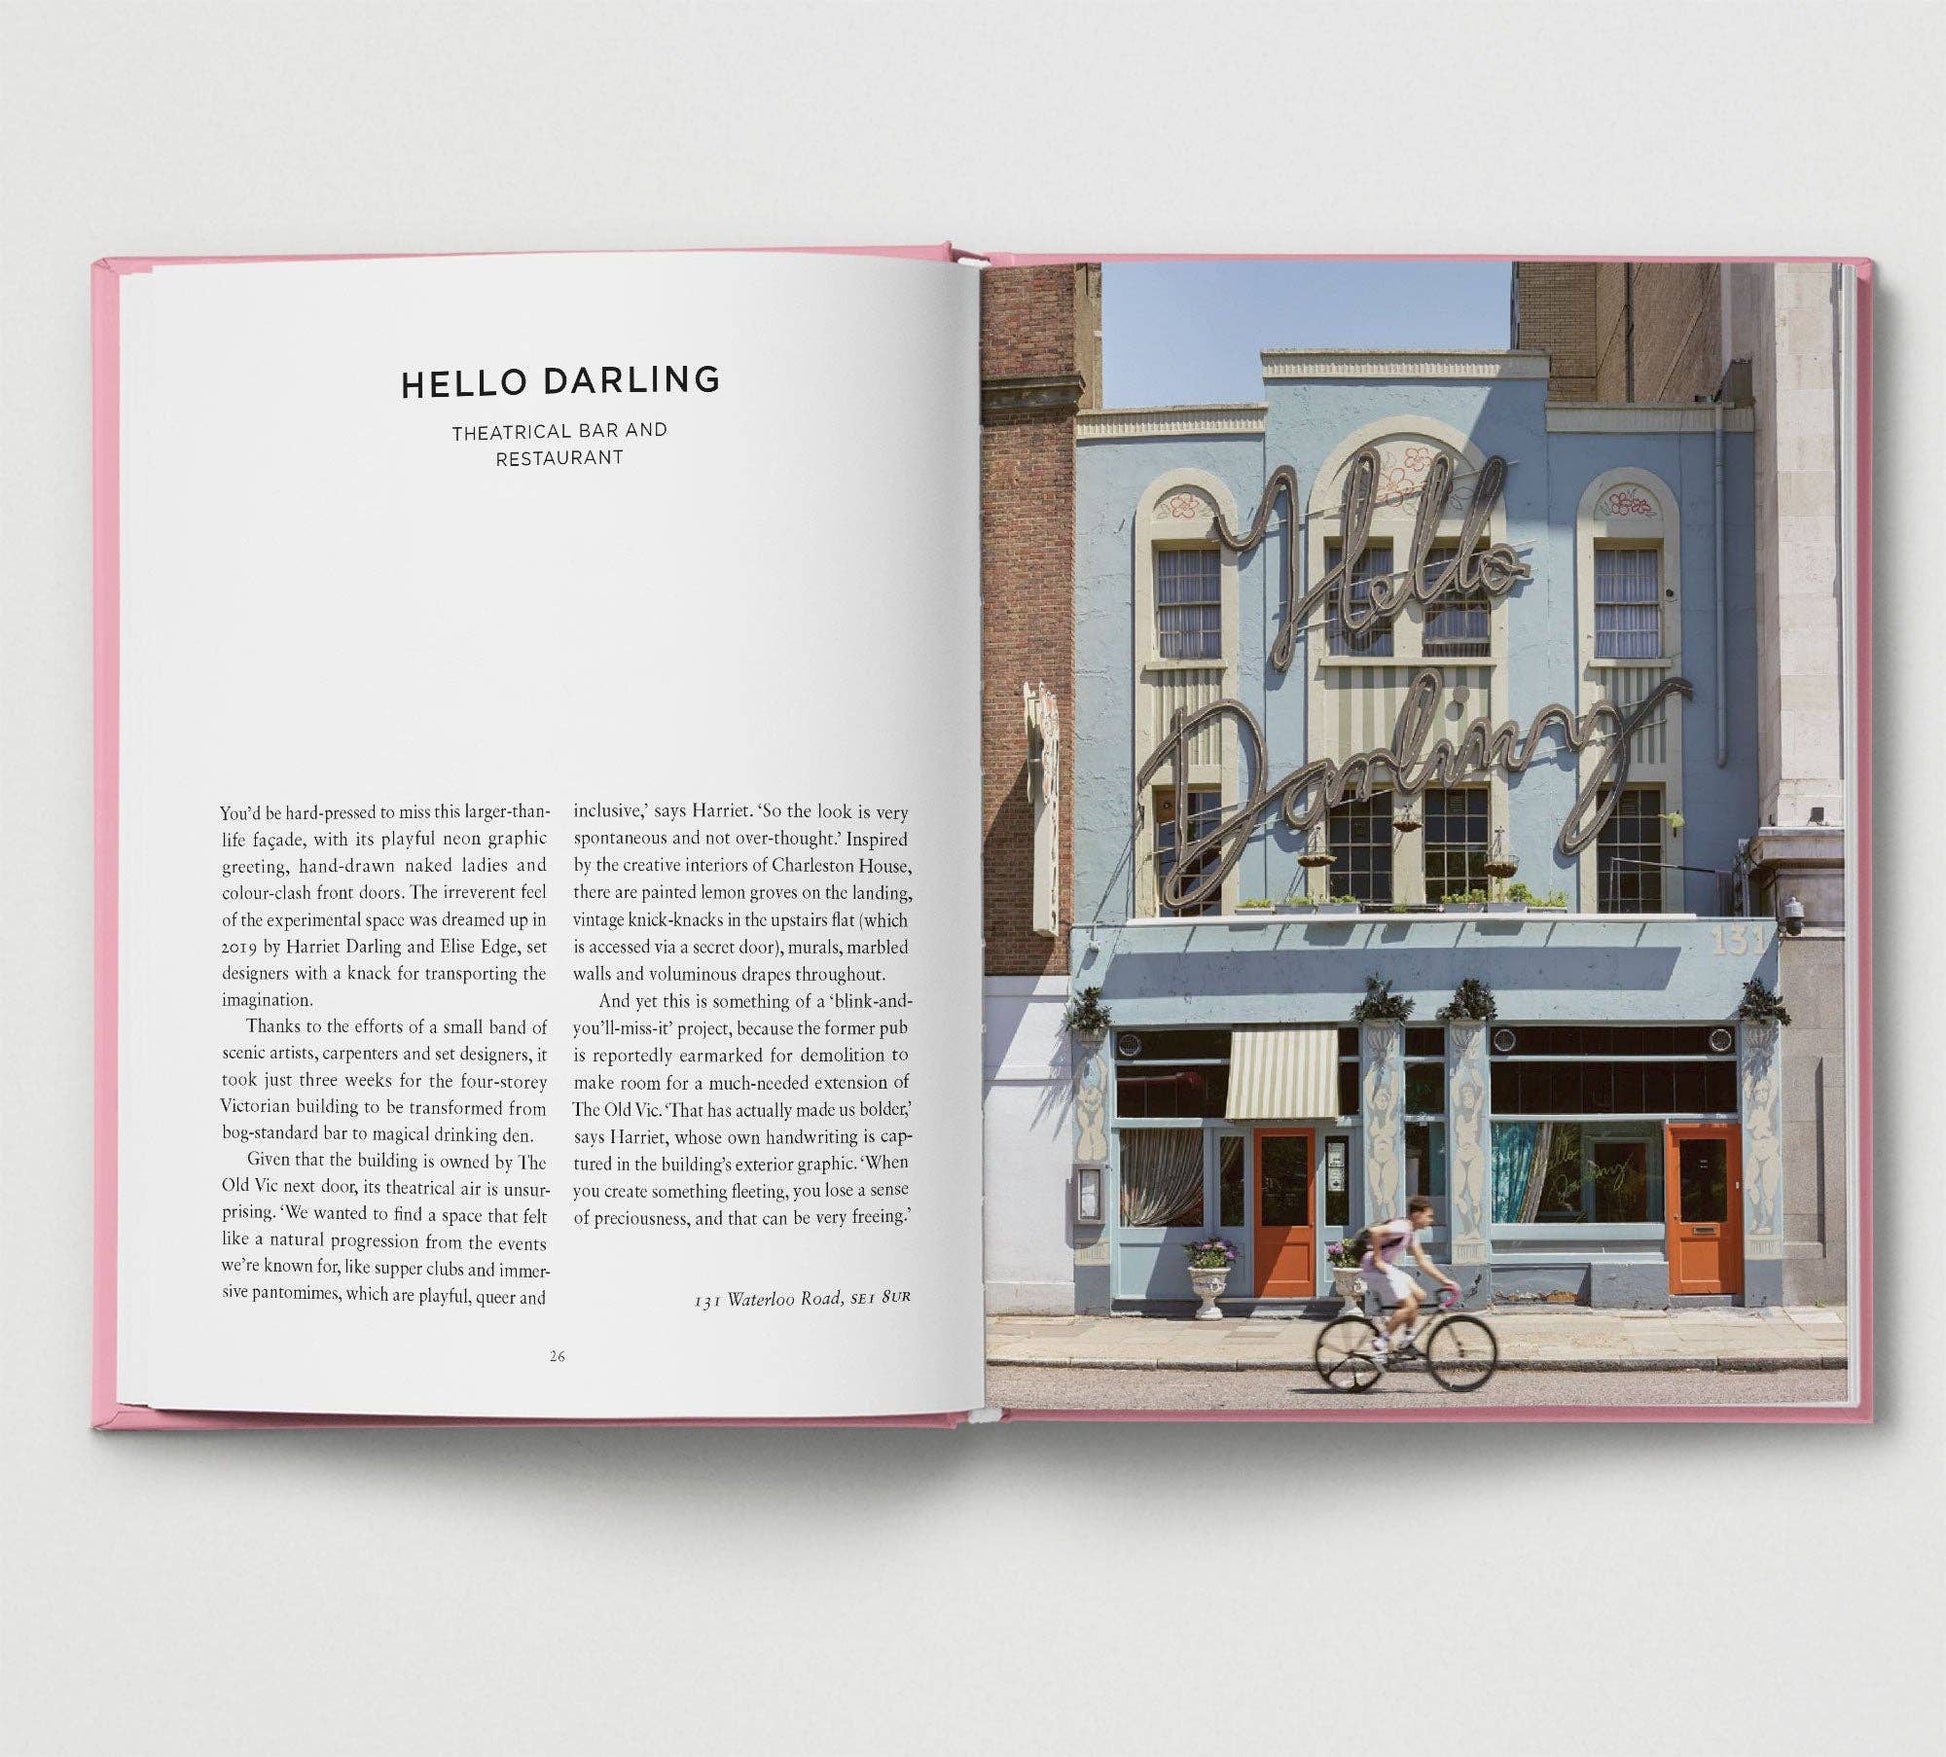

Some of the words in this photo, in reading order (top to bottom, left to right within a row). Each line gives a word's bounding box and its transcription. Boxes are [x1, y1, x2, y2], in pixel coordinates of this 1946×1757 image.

[402, 368, 528, 399] HELLO
[544, 365, 720, 395] DARLING
[452, 423, 572, 442] THEATRICAL
[579, 422, 619, 439] BAR
[625, 421, 668, 438] AND
[496, 448, 624, 467] RESTAURANT
[1212, 446, 1533, 673] Hello
[1136, 668, 1694, 910] Darling
[265, 804, 282, 821] be
[286, 803, 377, 824] hard-pressed
[380, 807, 395, 820] to
[398, 803, 431, 820] miss
[434, 803, 461, 819] this
[465, 802, 551, 823] larger-than-
[574, 832, 668, 850] spontaneous
[672, 829, 700, 846] and
[705, 832, 731, 846] not
[846, 830, 908, 852] Inspired
[222, 858, 291, 879] greeting,
[298, 857, 395, 874] hand-drawn
[405, 856, 453, 873] naked
[461, 856, 508, 873] ladies
[516, 856, 548, 872] and
[573, 855, 592, 877] by
[596, 855, 620, 872] the
[622, 856, 682, 872] creative
[685, 856, 749, 873] interiors
[752, 856, 769, 873] of
[771, 856, 855, 873] Charleston
[858, 858, 913, 877] House,
[221, 884, 312, 901] colour-clash
[316, 883, 354, 900] front
[359, 883, 406, 900] doors.
[409, 883, 438, 900] The
[443, 884, 516, 901] irreverent
[520, 882, 548, 899] feel
[572, 911, 625, 932] vintage
[628, 910, 724, 927] knick-knacks
[727, 911, 741, 927] in
[744, 911, 768, 927] the
[770, 911, 828, 932] upstairs
[831, 910, 855, 927] flat
[859, 911, 908, 931] (which
[221, 942, 257, 957] 2019
[263, 938, 281, 958] by
[285, 937, 341, 955] Harriet
[346, 937, 402, 959] Darling
[407, 938, 435, 954] and
[439, 937, 475, 954] Elise
[480, 938, 522, 958] Edge,
[526, 941, 548, 954] set
[1711, 922, 1766, 956] 131
[572, 964, 612, 981] walls
[616, 965, 644, 982] and
[648, 965, 737, 982] voluminous
[741, 965, 792, 987] drapes
[795, 965, 886, 987] throughout.
[221, 991, 313, 1011] imagination.
[677, 1020, 733, 1040] project,
[737, 1019, 794, 1036] because
[797, 1019, 821, 1036] the
[824, 1018, 876, 1036] former
[878, 1018, 908, 1040] pub
[222, 1044, 266, 1060] scenic
[269, 1045, 319, 1063] artists,
[322, 1047, 399, 1065] carpenters
[403, 1045, 431, 1061] and
[435, 1048, 456, 1062] set
[459, 1045, 533, 1066] designers,
[536, 1046, 548, 1063] it
[573, 1046, 586, 1063] is
[592, 1046, 673, 1068] reportedly
[679, 1046, 764, 1063] earmarked
[770, 1046, 793, 1064] for
[800, 1046, 885, 1063] demolition
[891, 1049, 909, 1062] to
[574, 1073, 615, 1090] make
[620, 1079, 662, 1091] room
[665, 1074, 689, 1091] for
[694, 1079, 704, 1091] a
[708, 1074, 809, 1091] much-needed
[814, 1074, 888, 1090] extension
[893, 1072, 911, 1089] of
[219, 1097, 291, 1113] Victorian
[296, 1097, 359, 1118] building
[363, 1101, 380, 1114] to
[386, 1098, 404, 1114] be
[409, 1098, 503, 1116] transformed
[508, 1099, 547, 1117] from
[222, 1123, 318, 1144] bog-standard
[323, 1124, 349, 1140] bar
[352, 1128, 368, 1141] to
[372, 1125, 430, 1146] magical
[434, 1125, 498, 1147] drinking
[502, 1126, 534, 1143] den.
[574, 1132, 605, 1148] says
[610, 1128, 670, 1148] Harriet,
[674, 1128, 723, 1145] whose
[727, 1133, 761, 1145] own
[766, 1128, 859, 1148] handwriting
[863, 1128, 876, 1144] is
[880, 1131, 913, 1147] cap-
[574, 1155, 612, 1172] tured
[617, 1156, 630, 1172] in
[634, 1155, 657, 1172] the
[735, 1156, 795, 1173] exterior
[797, 1155, 858, 1176] graphic.
[221, 1176, 250, 1193] Old
[254, 1177, 279, 1193] Vic
[283, 1180, 316, 1193] next
[321, 1177, 359, 1197] door,
[363, 1178, 381, 1194] its
[385, 1178, 455, 1196] theatrical
[460, 1180, 482, 1196] air
[486, 1181, 499, 1197] is
[503, 1186, 551, 1198] unsur-
[573, 1208, 591, 1227] of
[593, 1210, 692, 1230] preciousness,
[695, 1209, 723, 1226] and
[728, 1209, 758, 1226] that
[762, 1214, 788, 1226] can
[793, 1209, 811, 1225] be
[815, 1213, 847, 1228] very
[222, 1229, 250, 1246] like
[255, 1234, 264, 1246] a
[270, 1231, 325, 1247] natural
[330, 1233, 419, 1253] progression
[425, 1233, 463, 1250] from
[468, 1234, 493, 1250] the
[498, 1238, 547, 1252] events
[222, 1283, 249, 1298] sive
[252, 1284, 343, 1304] pantomimes,
[345, 1285, 389, 1302] which
[392, 1291, 415, 1302] are
[418, 1286, 473, 1308] playful,
[475, 1293, 517, 1309] queer
[519, 1289, 546, 1306] and
[695, 1296, 720, 1311] 131
[728, 1291, 795, 1307] Waterloo
[801, 1290, 845, 1307] Road,
[549, 1350, 566, 1363] 26
